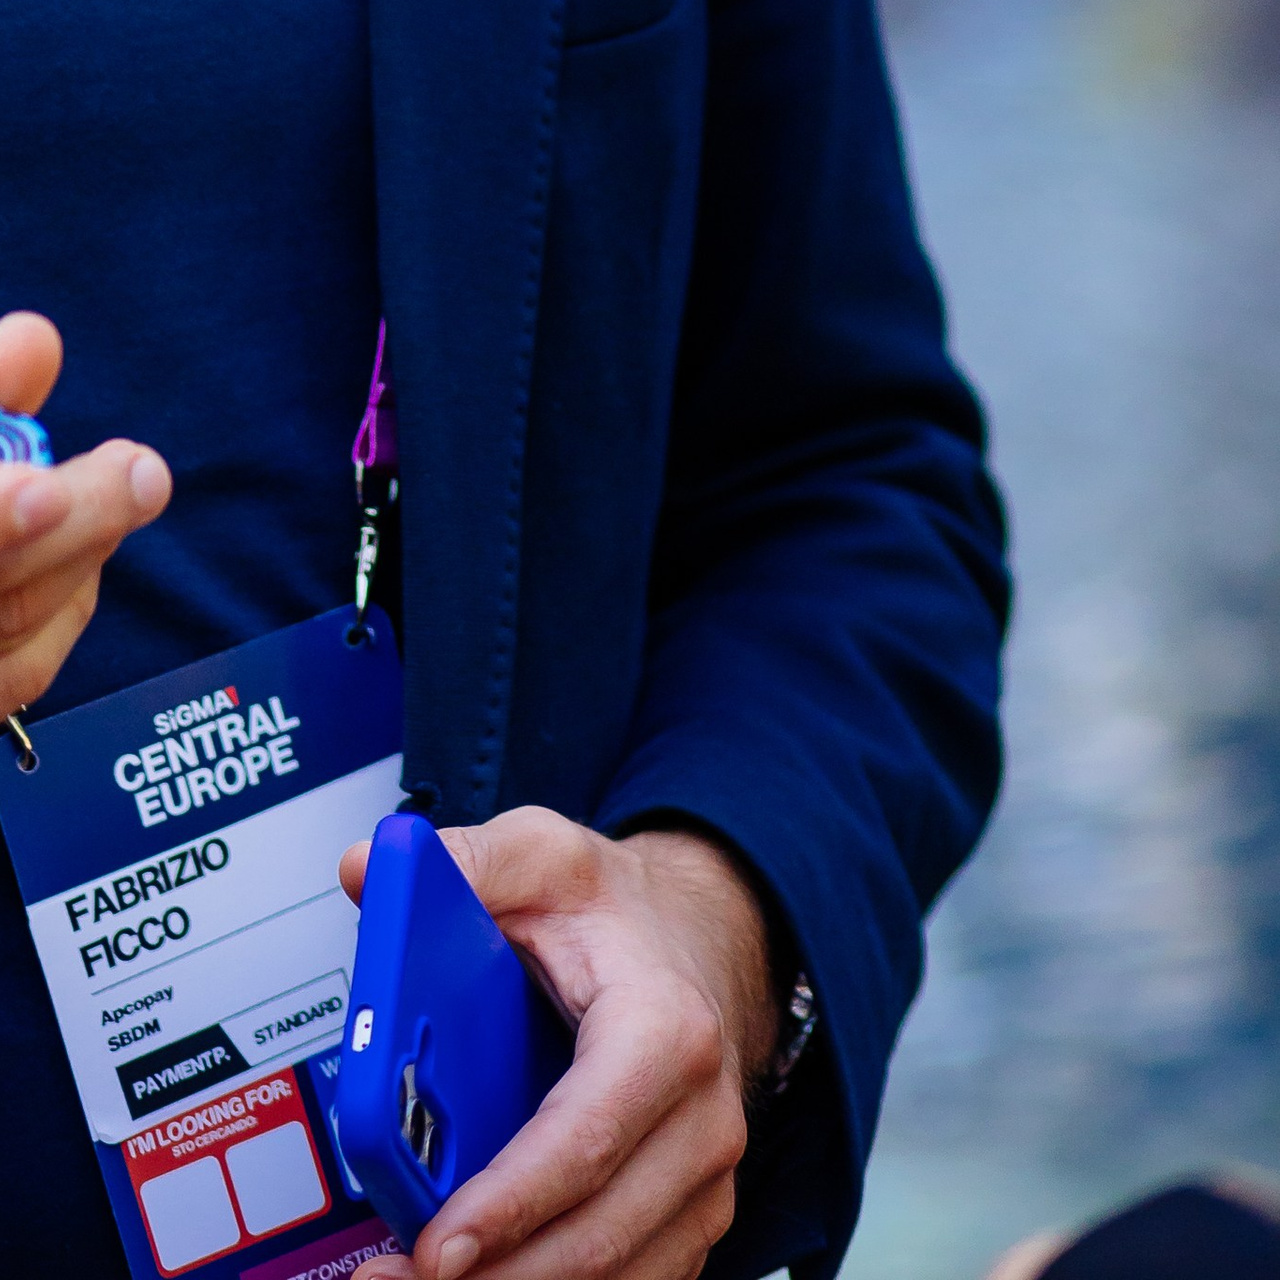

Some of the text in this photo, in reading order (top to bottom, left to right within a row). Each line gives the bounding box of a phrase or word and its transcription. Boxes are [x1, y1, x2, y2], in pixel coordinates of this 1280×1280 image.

[113, 696, 301, 792] CENTRAL
[134, 734, 300, 828] EUROPE
[64, 837, 230, 933] FABRIZIO
[79, 906, 191, 978] FICCO
[101, 984, 174, 1026] Apcopay
[107, 1017, 162, 1053] SBDM
[254, 996, 343, 1046] STANDARD
[127, 1079, 293, 1159] I'M LOOKING FOR:
[171, 1138, 196, 1158] STO
